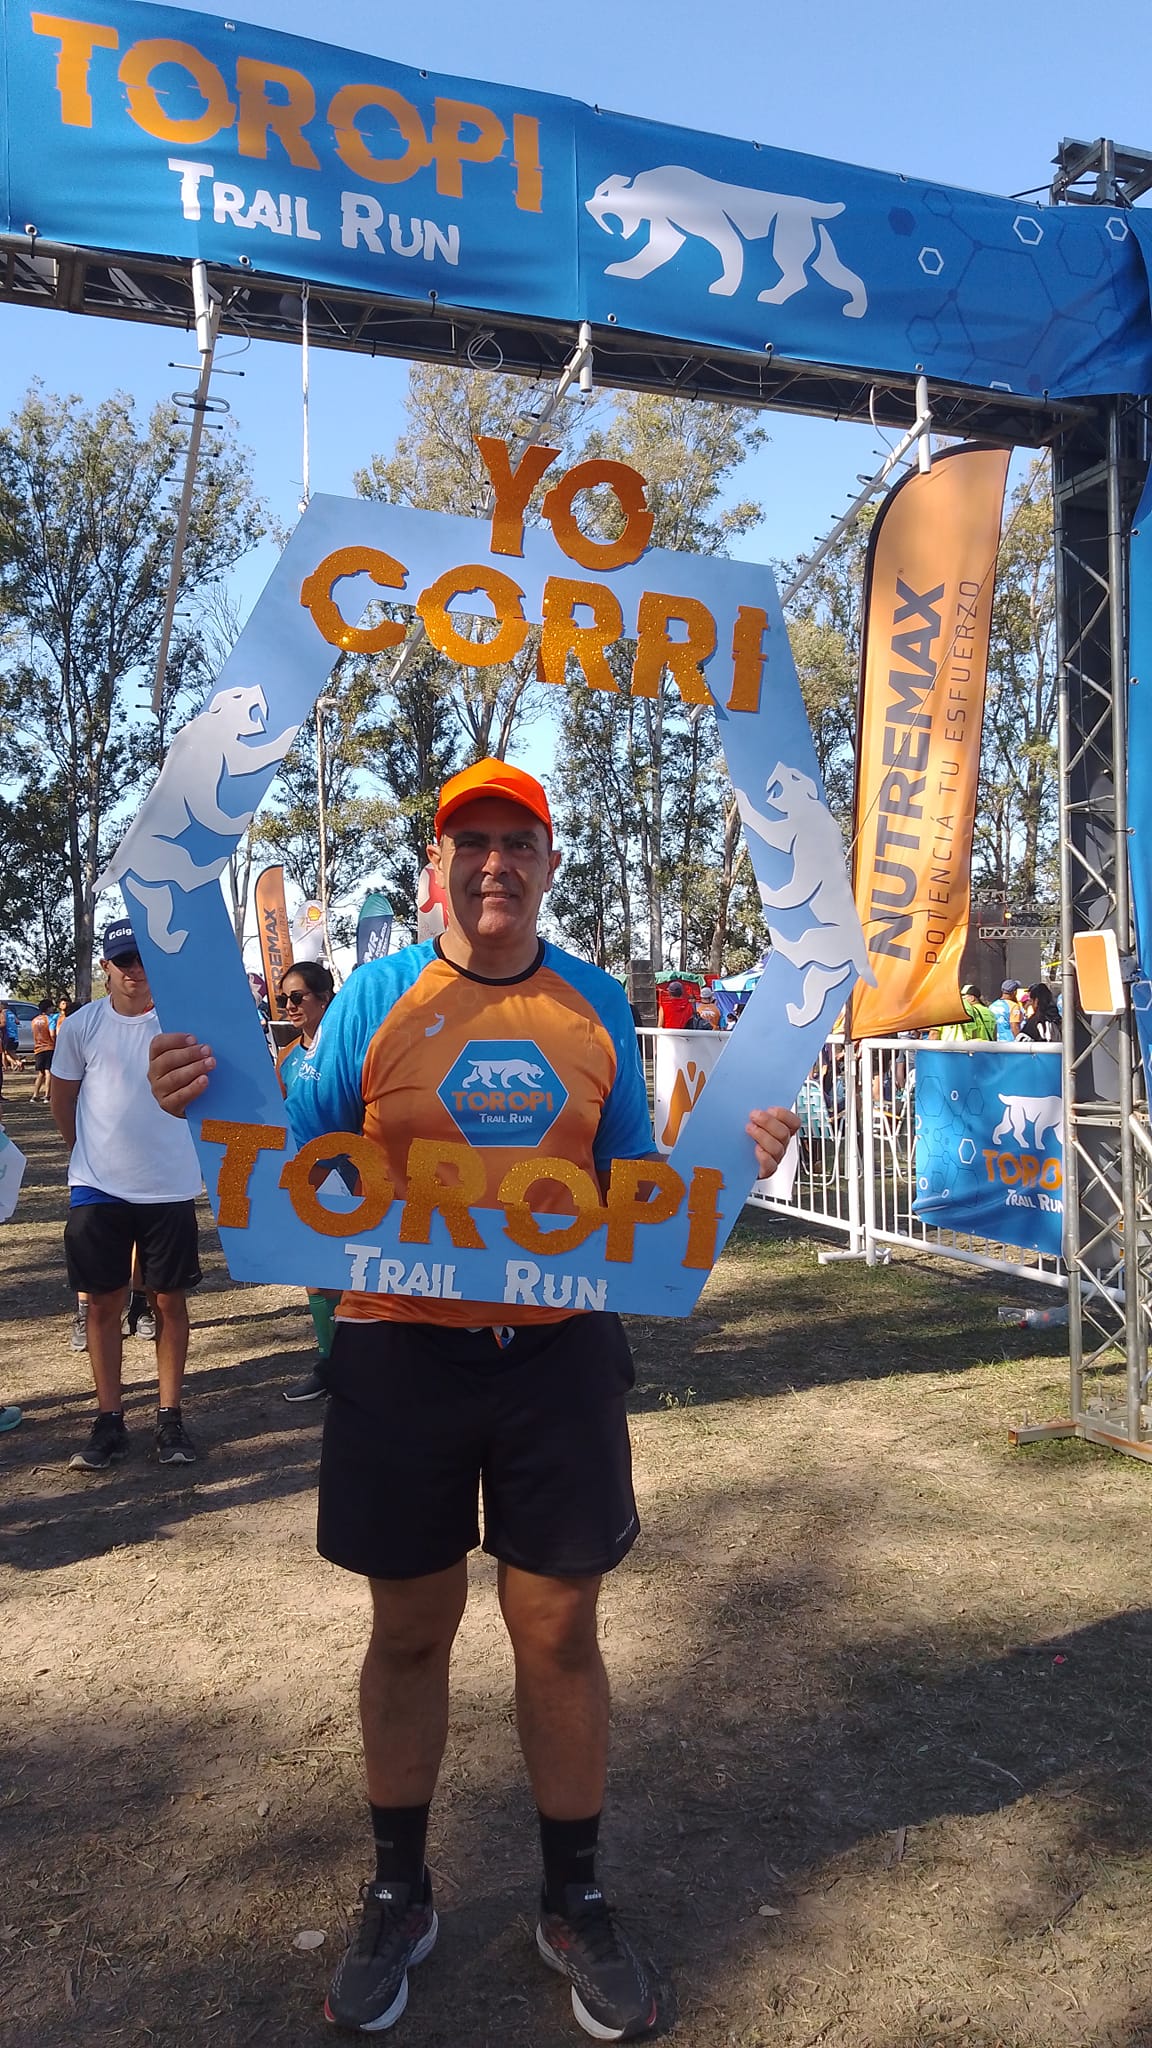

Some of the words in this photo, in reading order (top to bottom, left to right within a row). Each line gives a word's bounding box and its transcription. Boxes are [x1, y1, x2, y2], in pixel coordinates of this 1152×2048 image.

[31, 12, 543, 213] TOROPI
[167, 158, 321, 241] TRAIL
[340, 191, 459, 266] RUN
[473, 435, 654, 571] YO
[300, 545, 769, 713] CORRI
[945, 581, 980, 741] ESFUERZO
[868, 577, 945, 961] NUTREMAX
[939, 761, 960, 794] TU
[115, 927, 134, 937] Gig
[925, 815, 955, 964] POTENCIÁ
[451, 1091, 553, 1111] TOROPI
[479, 1113, 506, 1123] TRAIL
[509, 1113, 533, 1124] RUN
[201, 1119, 725, 1270] TOROPI
[1005, 1189, 1037, 1208] TRAIL
[344, 1243, 462, 1299] TRAIL
[504, 1259, 608, 1311] RUN
